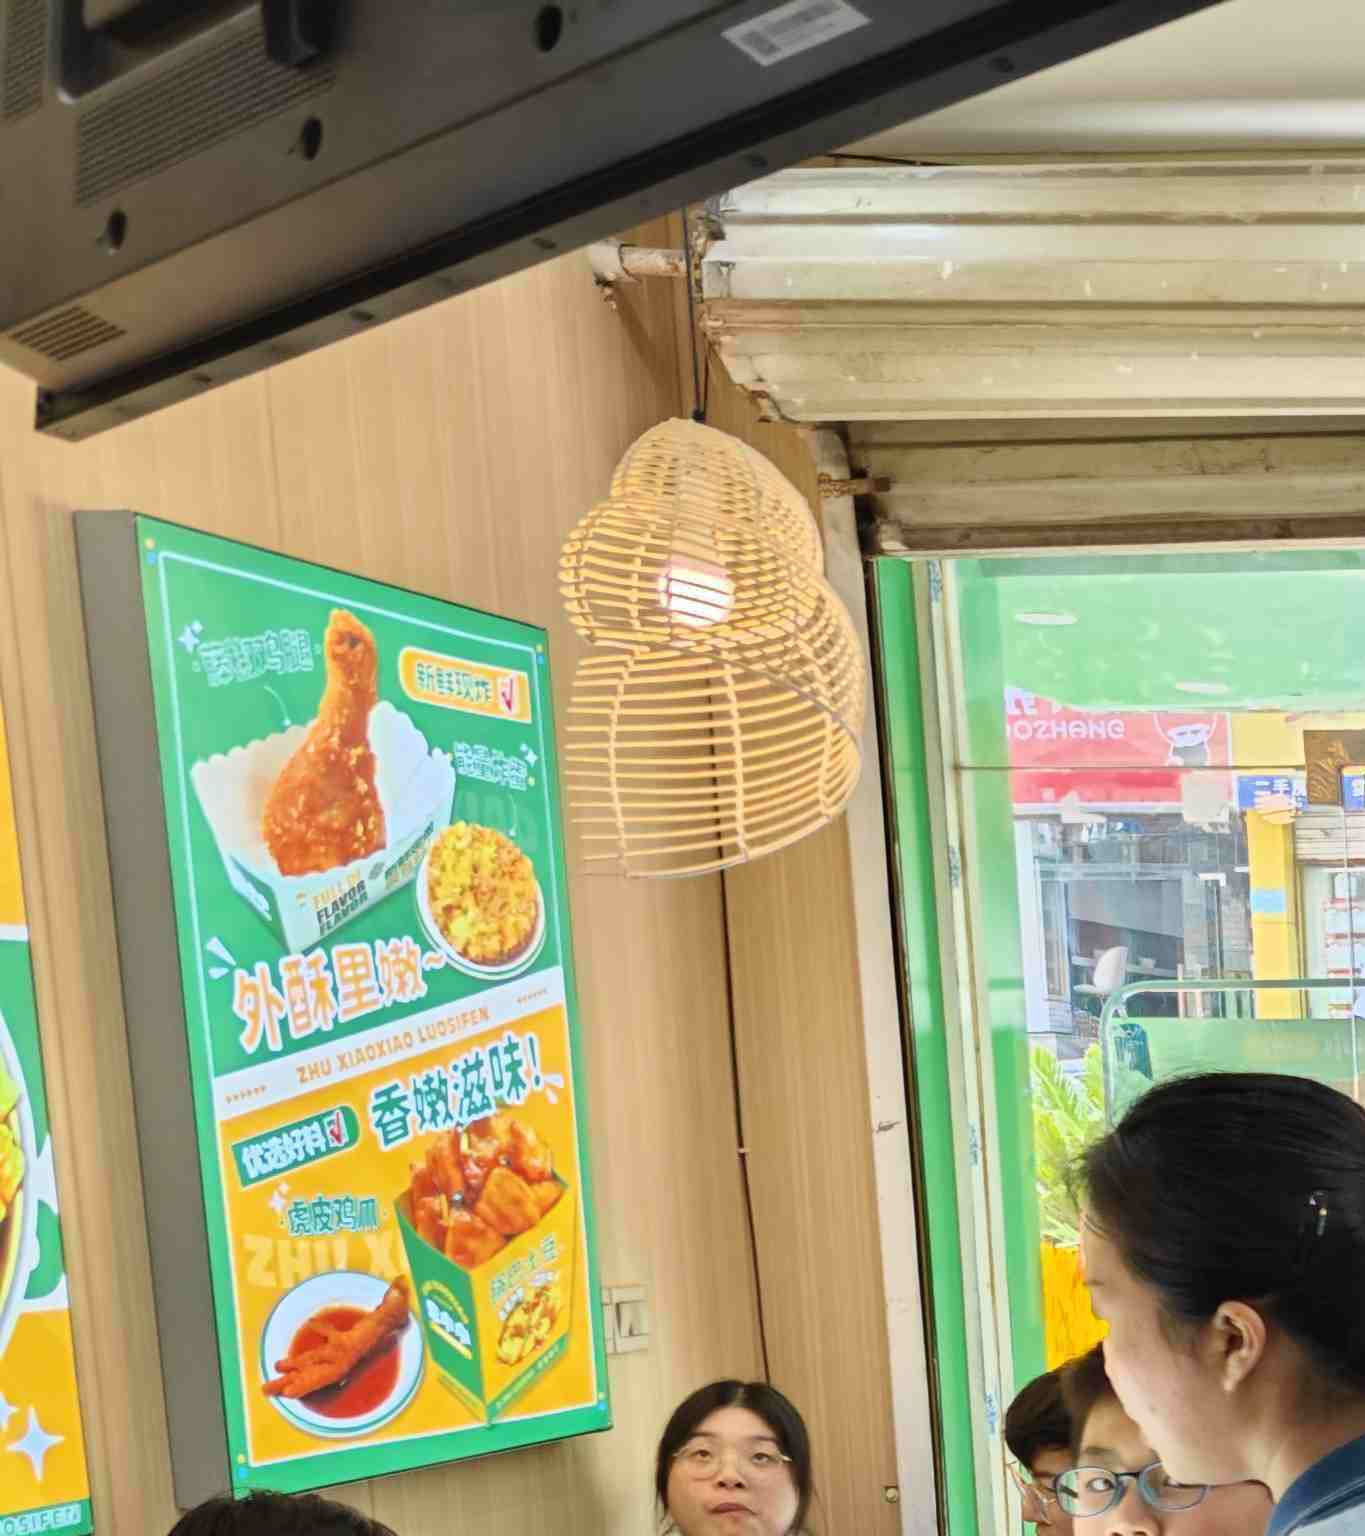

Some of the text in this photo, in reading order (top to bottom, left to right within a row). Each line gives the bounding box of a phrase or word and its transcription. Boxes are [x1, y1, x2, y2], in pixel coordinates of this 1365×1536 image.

[296, 1006, 491, 1084] ZHU XIAOXIAO LUOSIFEN
[242, 1122, 327, 1180] 优选好料
